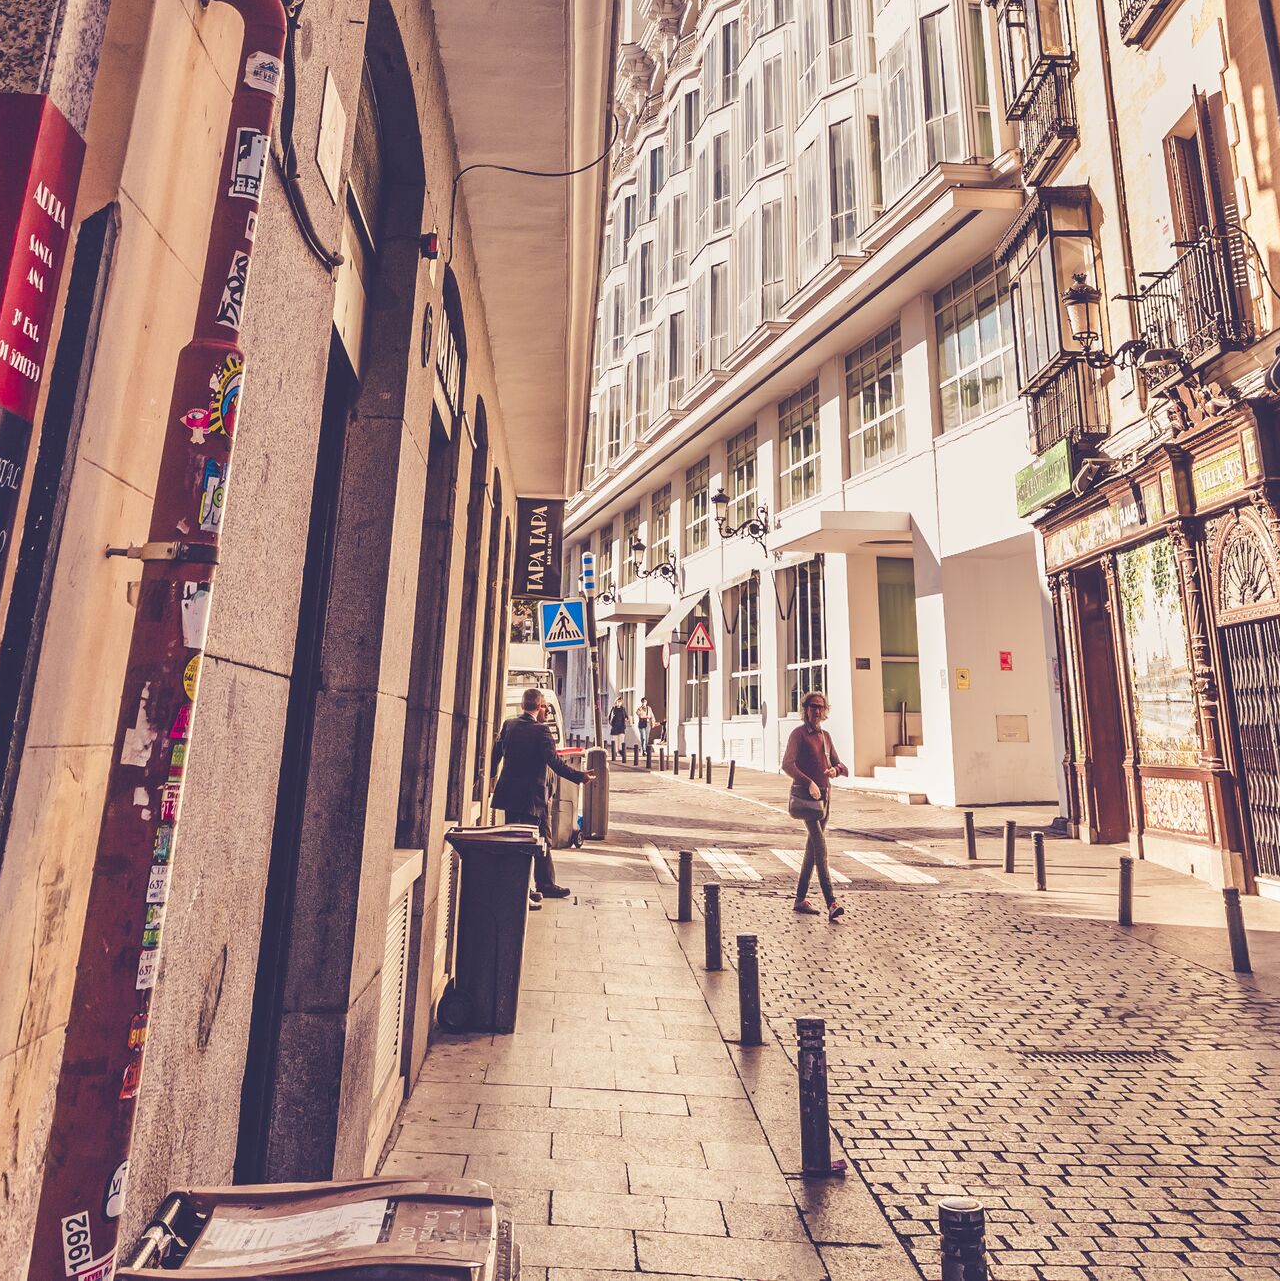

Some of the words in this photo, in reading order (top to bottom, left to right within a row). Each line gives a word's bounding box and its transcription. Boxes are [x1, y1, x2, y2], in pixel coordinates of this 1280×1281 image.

[32, 181, 66, 230] ADRIA
[28, 234, 54, 269] SANTA
[26, 267, 44, 293] ANA
[22, 316, 40, 343] Ext.
[9, 348, 41, 383] 5211339
[529, 505, 548, 546] TAPA
[526, 550, 545, 592] TAPA
[65, 1214, 91, 1273] 1992
